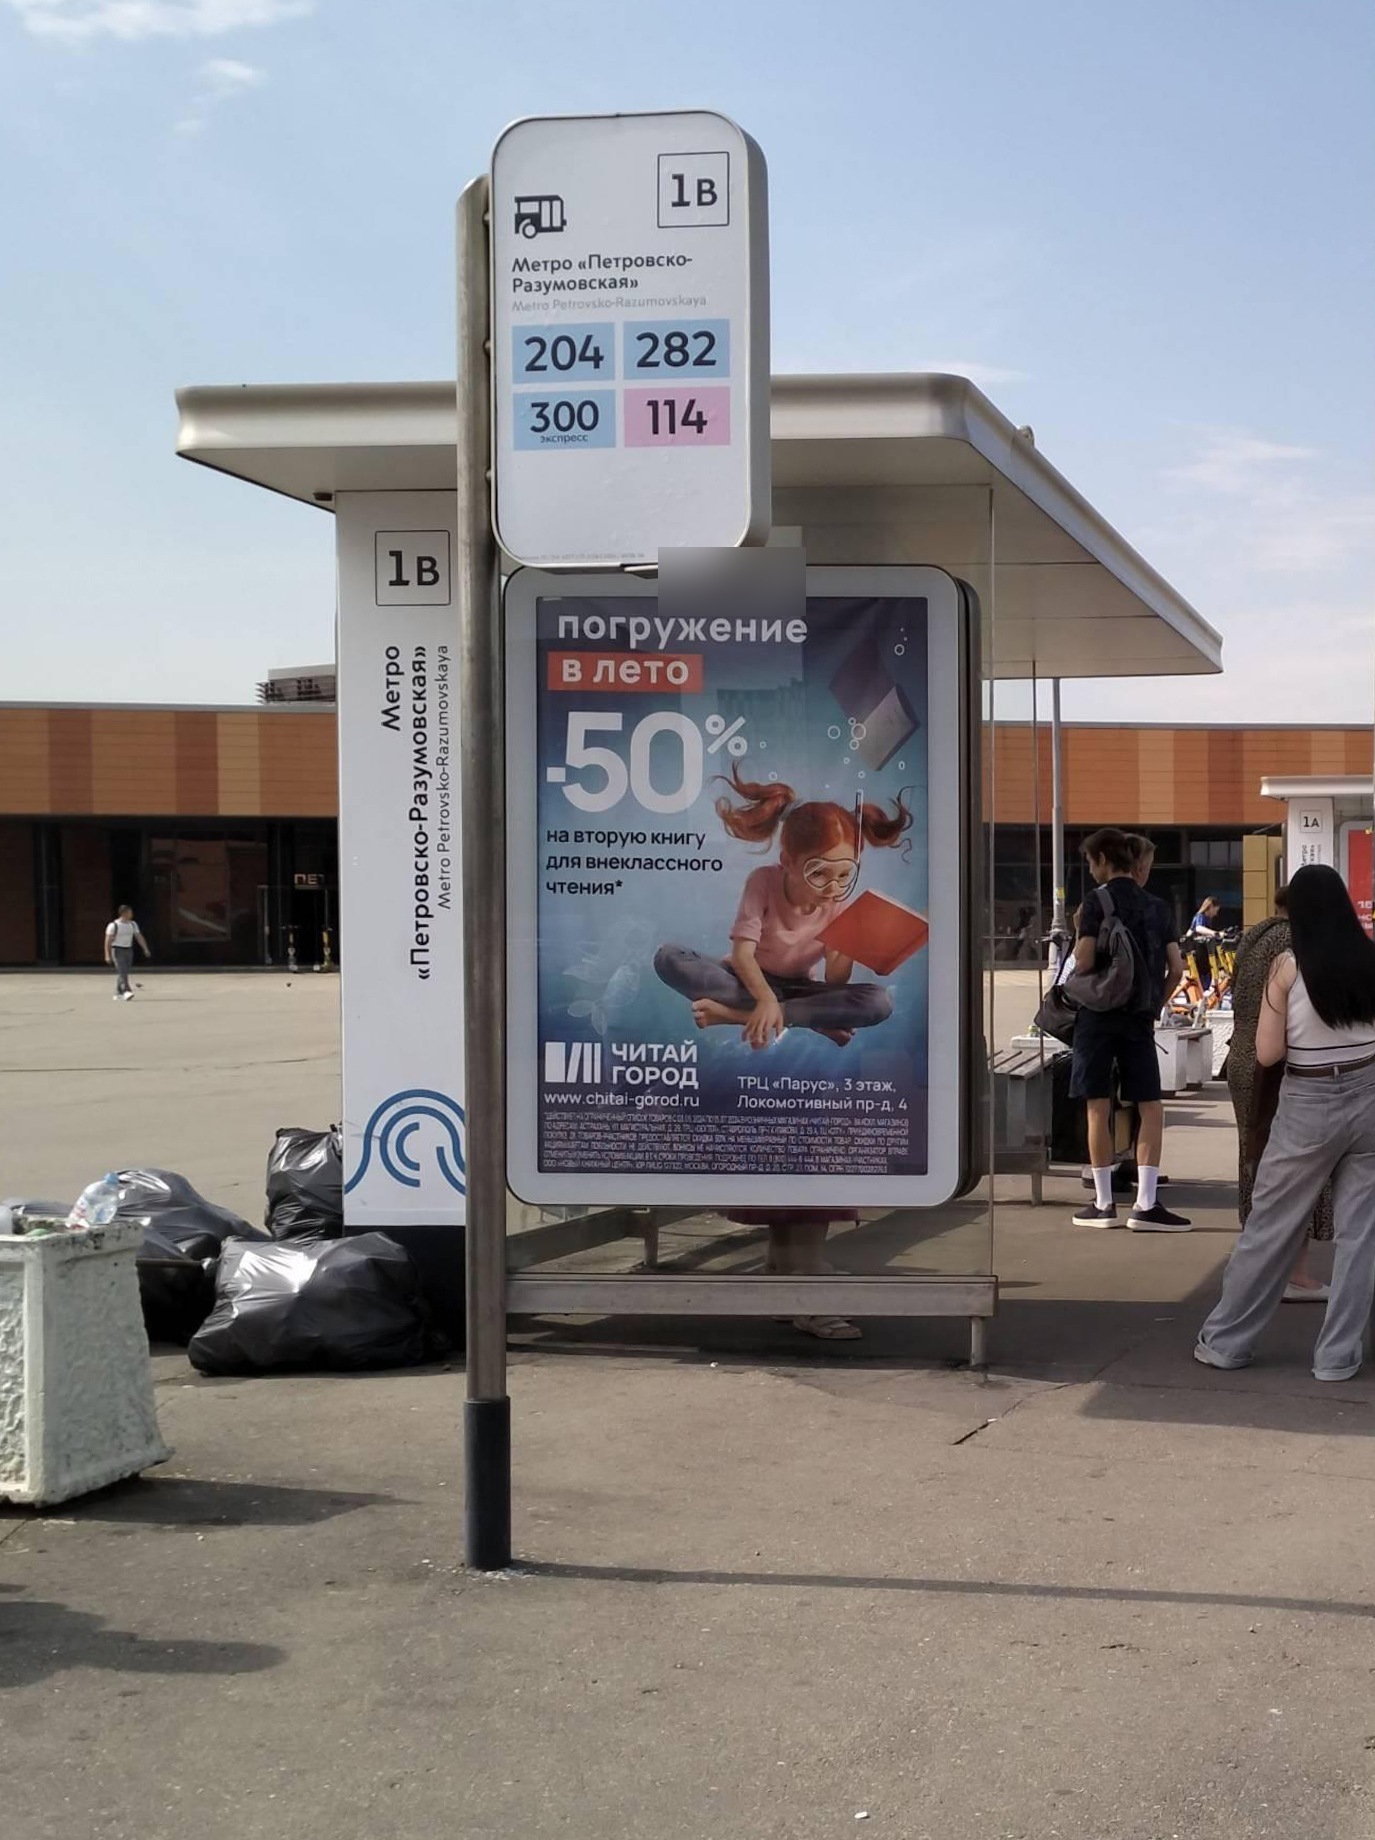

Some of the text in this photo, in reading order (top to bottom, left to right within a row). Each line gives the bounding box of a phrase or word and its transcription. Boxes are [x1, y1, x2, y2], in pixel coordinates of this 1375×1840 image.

[671, 173, 718, 208] 1В
[512, 253, 692, 274] Метро «Петровско-
[512, 276, 638, 295] Разумовская»
[512, 295, 707, 312] Metro Petrovsko-Razumovskaya
[524, 335, 604, 372] 204
[637, 330, 717, 368] 282
[530, 400, 599, 433] 300
[647, 398, 707, 434] 114
[540, 433, 588, 444] экспресс
[388, 550, 440, 587] 1В
[558, 615, 808, 650] погружение
[562, 659, 689, 685] в лето
[381, 645, 403, 732] Метро
[546, 711, 748, 814] -50%
[436, 645, 451, 909] Metro Petrovsko-Razumovskaya
[409, 645, 433, 982] «Петровско-Разумовская»
[1303, 816, 1320, 828] 1А
[546, 830, 706, 848] на вторую книгу
[546, 856, 723, 872] для внеклассного
[612, 1040, 698, 1063] ЧИТАЙ
[612, 1066, 699, 1088] ГОРОД
[738, 1076, 896, 1094] ТРЦ «Парус», 3 этаж,
[544, 1093, 700, 1110] www.chitai-gorod.ru
[738, 1095, 908, 1114] Локомотивный пр-д, 4
